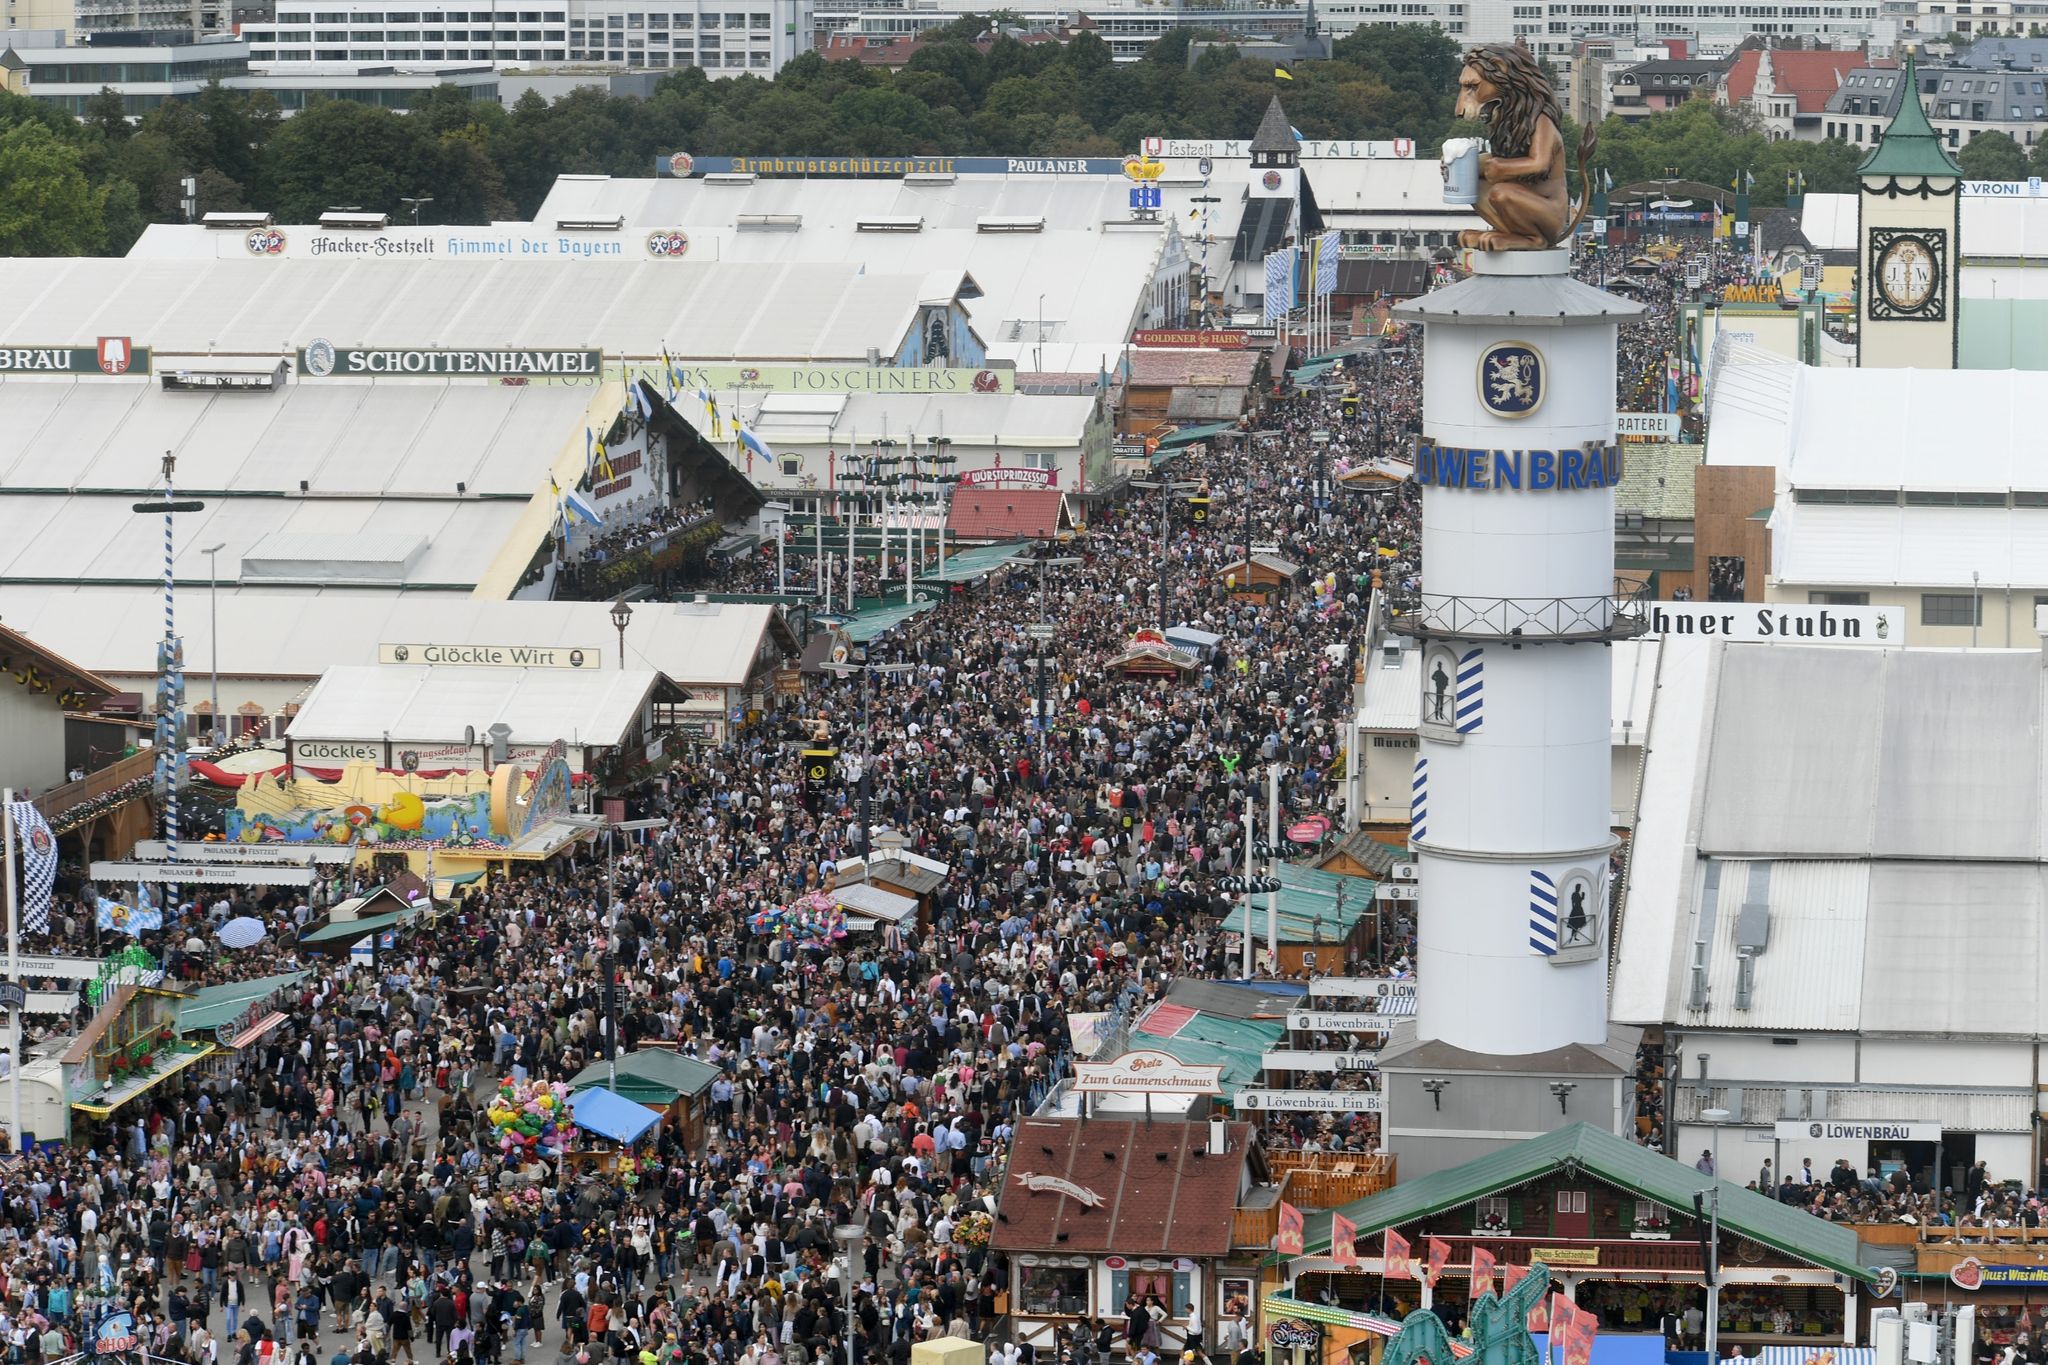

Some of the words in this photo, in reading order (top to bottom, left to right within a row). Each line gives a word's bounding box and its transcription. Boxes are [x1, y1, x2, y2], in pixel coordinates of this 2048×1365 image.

[1225, 142, 1377, 157] MTALL
[731, 157, 954, 173] Armbrustschützenzelt
[1007, 160, 1088, 173] PAULANER
[1972, 184, 2019, 194] VRONI
[311, 236, 435, 257] Hacker-Festzelt
[448, 238, 513, 256] Himmel
[521, 239, 549, 255] der
[558, 239, 622, 257] Bayern
[1144, 333, 1196, 343] GOLDENER
[1212, 334, 1240, 344] HAHN
[348, 351, 596, 374] SCHOTTENHAMEL
[793, 370, 957, 390] POSCHNER'S
[1618, 417, 1669, 432] RATEREI
[885, 583, 945, 595] SCHOTENHAMEL
[1653, 606, 1735, 635] hner
[1757, 609, 1861, 638] Stubn
[424, 646, 503, 664] Glöckle
[510, 648, 555, 665] Wirt
[298, 743, 377, 759] Glöckle's
[506, 748, 537, 760] Essen
[203, 847, 238, 855] PAULANER
[248, 848, 279, 856] FESTZELT
[159, 869, 194, 877] PAULANER
[205, 869, 236, 877] FESTZELT
[21, 960, 55, 970] FESTZELT
[1318, 1017, 1384, 1029] Löwenbräu.
[1082, 1073, 1109, 1085] Zum
[1112, 1074, 1212, 1088] Gaumenschmaus
[1266, 1095, 1338, 1108] Löwenbräu.
[1343, 1097, 1369, 1109] Ein
[1372, 1098, 1382, 1109] Bi
[1826, 1123, 1910, 1139] LÖWENBRÄU
[1983, 1268, 2008, 1281] TILLES
[96, 1334, 138, 1355] SHOP
